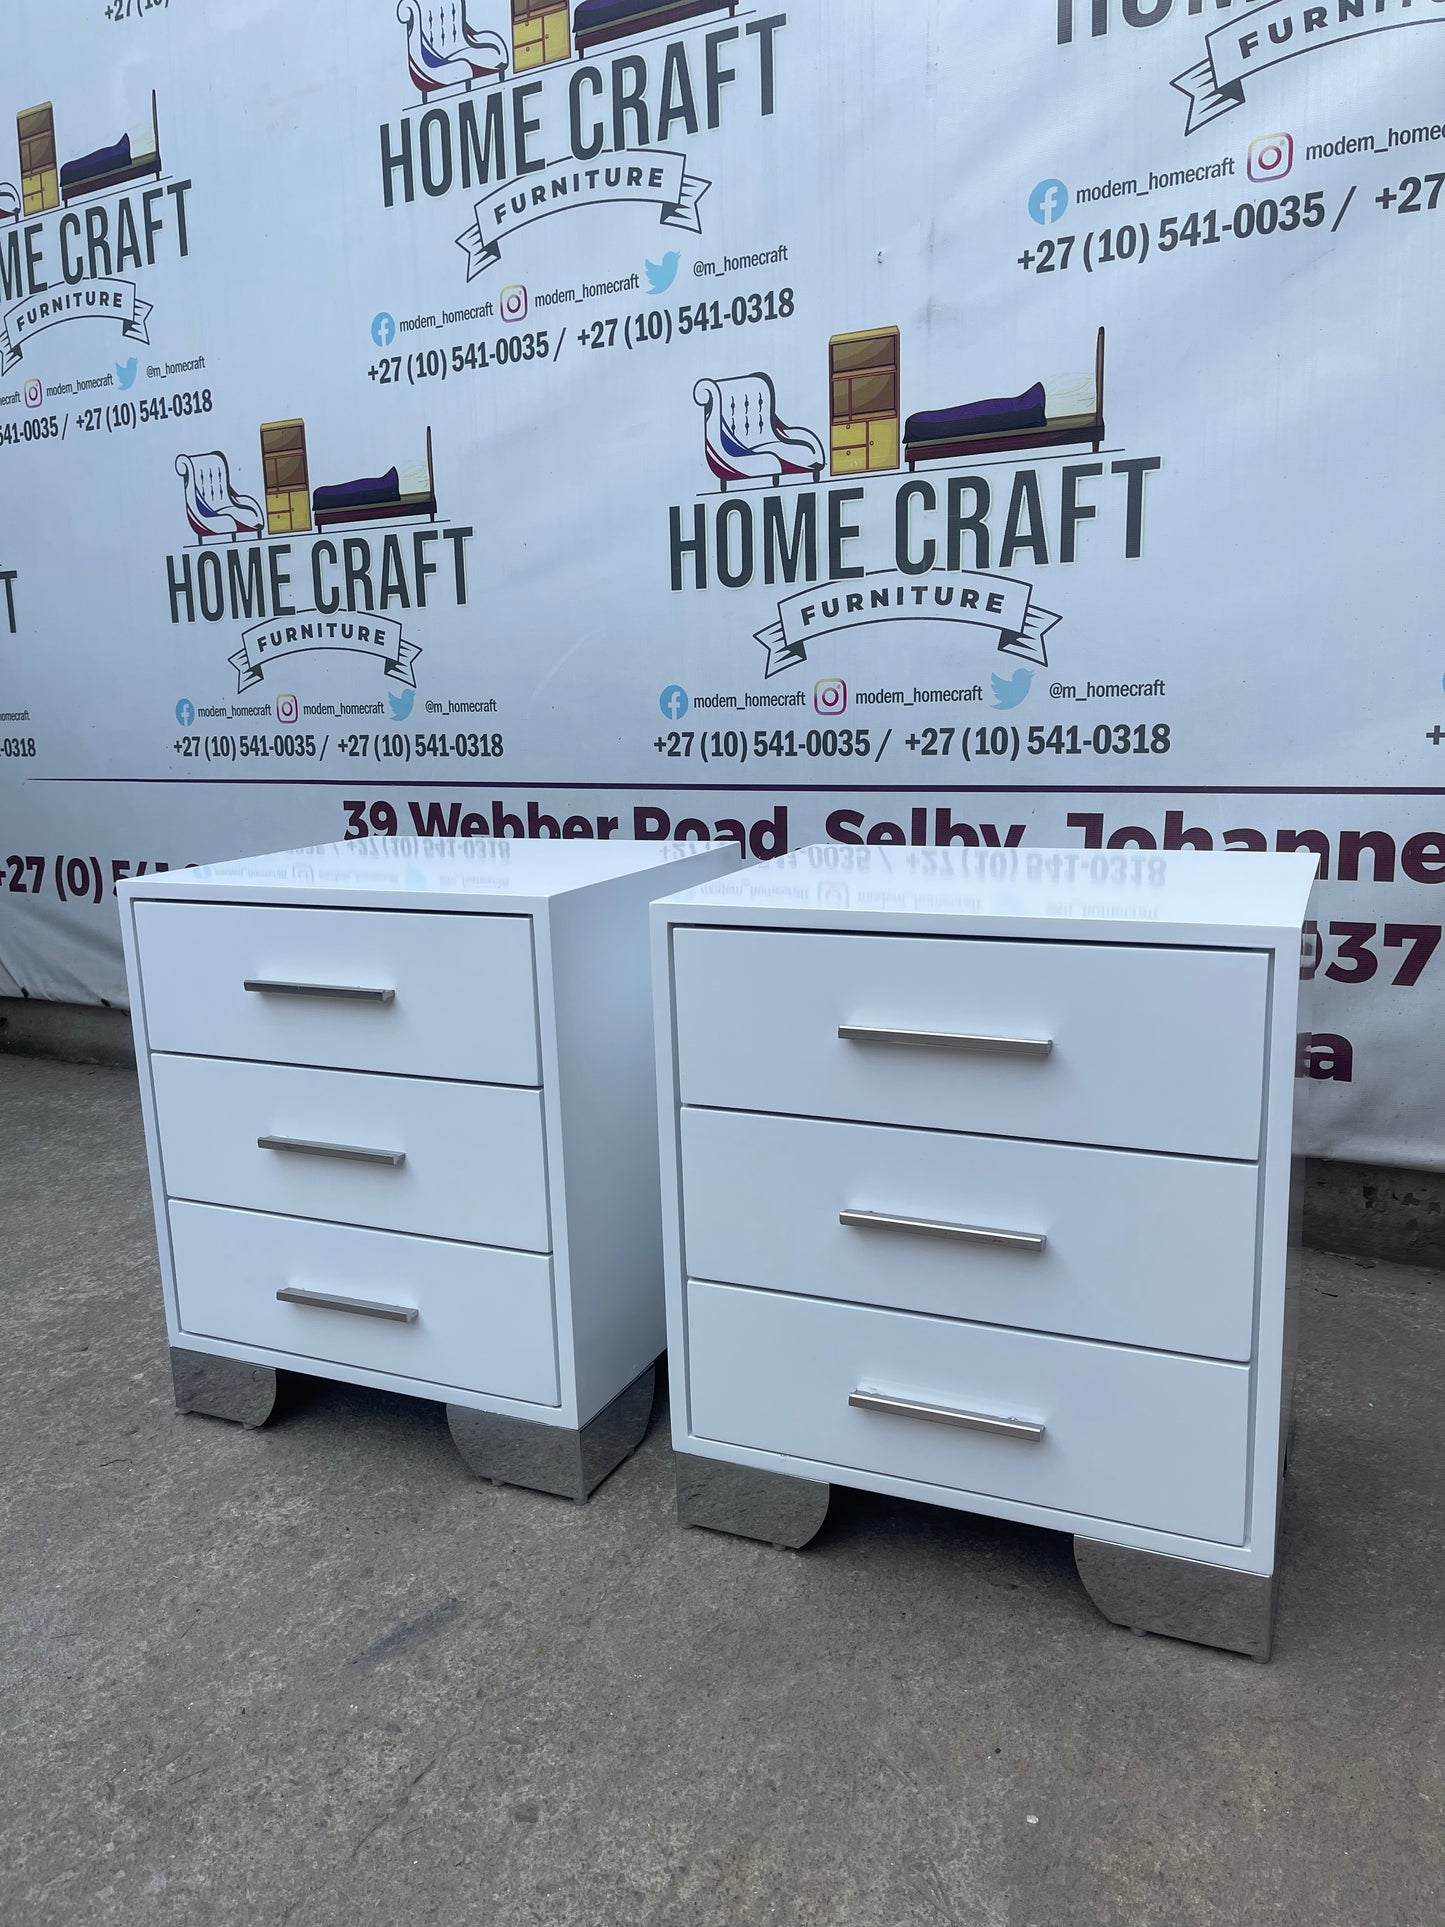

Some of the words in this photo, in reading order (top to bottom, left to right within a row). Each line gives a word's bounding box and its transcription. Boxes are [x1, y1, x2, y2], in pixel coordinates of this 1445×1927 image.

[1238, 0, 1445, 59] FURN
[380, 81, 546, 207] HOME
[569, 14, 787, 160] CRAFT
[494, 167, 664, 224] FURNITURE
[1076, 157, 1235, 204] modern_homecraft
[60, 179, 192, 286] CRAFT
[1017, 236, 1075, 274] +27
[1084, 223, 1149, 272] (10)
[1158, 191, 1325, 252] 541-0035
[16, 291, 123, 332] FURNITURE
[399, 302, 494, 332] modern_homecraft
[535, 273, 640, 308] modern_homecraft
[694, 245, 788, 277] @m_homecraft
[368, 356, 402, 384] +27
[407, 349, 447, 385] (10)
[452, 331, 549, 372] 541-0035
[577, 318, 618, 349] +27
[624, 309, 673, 350] (10)
[678, 287, 795, 335] 541-0318
[46, 373, 114, 397] modern_homecraft
[146, 356, 206, 379] @m_homecraft
[76, 407, 102, 431] +27
[106, 402, 137, 433] (10)
[140, 388, 213, 423] 541-0318
[668, 487, 865, 591] HOME
[895, 456, 1161, 576] CRAFT
[166, 544, 296, 623] HOME
[311, 527, 473, 614] CRAFT
[800, 585, 1005, 626] FURNITURE
[257, 622, 386, 652] FURNITURE
[198, 704, 272, 719] modern_homecraft
[303, 701, 385, 717] modern_homecraft
[425, 699, 497, 715] @m_homecraft
[694, 691, 806, 710] modern_homecraft
[856, 685, 983, 706] modern_homecraft
[1049, 680, 1165, 701] @m_homecraft
[173, 736, 201, 757] +27
[205, 735, 236, 761] (10)
[239, 734, 316, 757] 541-0035
[338, 734, 369, 757] +27
[374, 734, 410, 762] (10)
[415, 733, 504, 757] 541-0318
[653, 731, 694, 757] +27
[700, 730, 748, 762] (10)
[753, 729, 871, 757] 541-0035
[905, 727, 955, 756] +27
[962, 726, 1020, 761] (10)
[1027, 723, 1171, 755] 541-0318
[343, 801, 398, 841] 39
[408, 801, 619, 841] Webber
[633, 806, 801, 861] Road
[55, 855, 103, 904] (0)
[1314, 920, 1442, 986] 37
